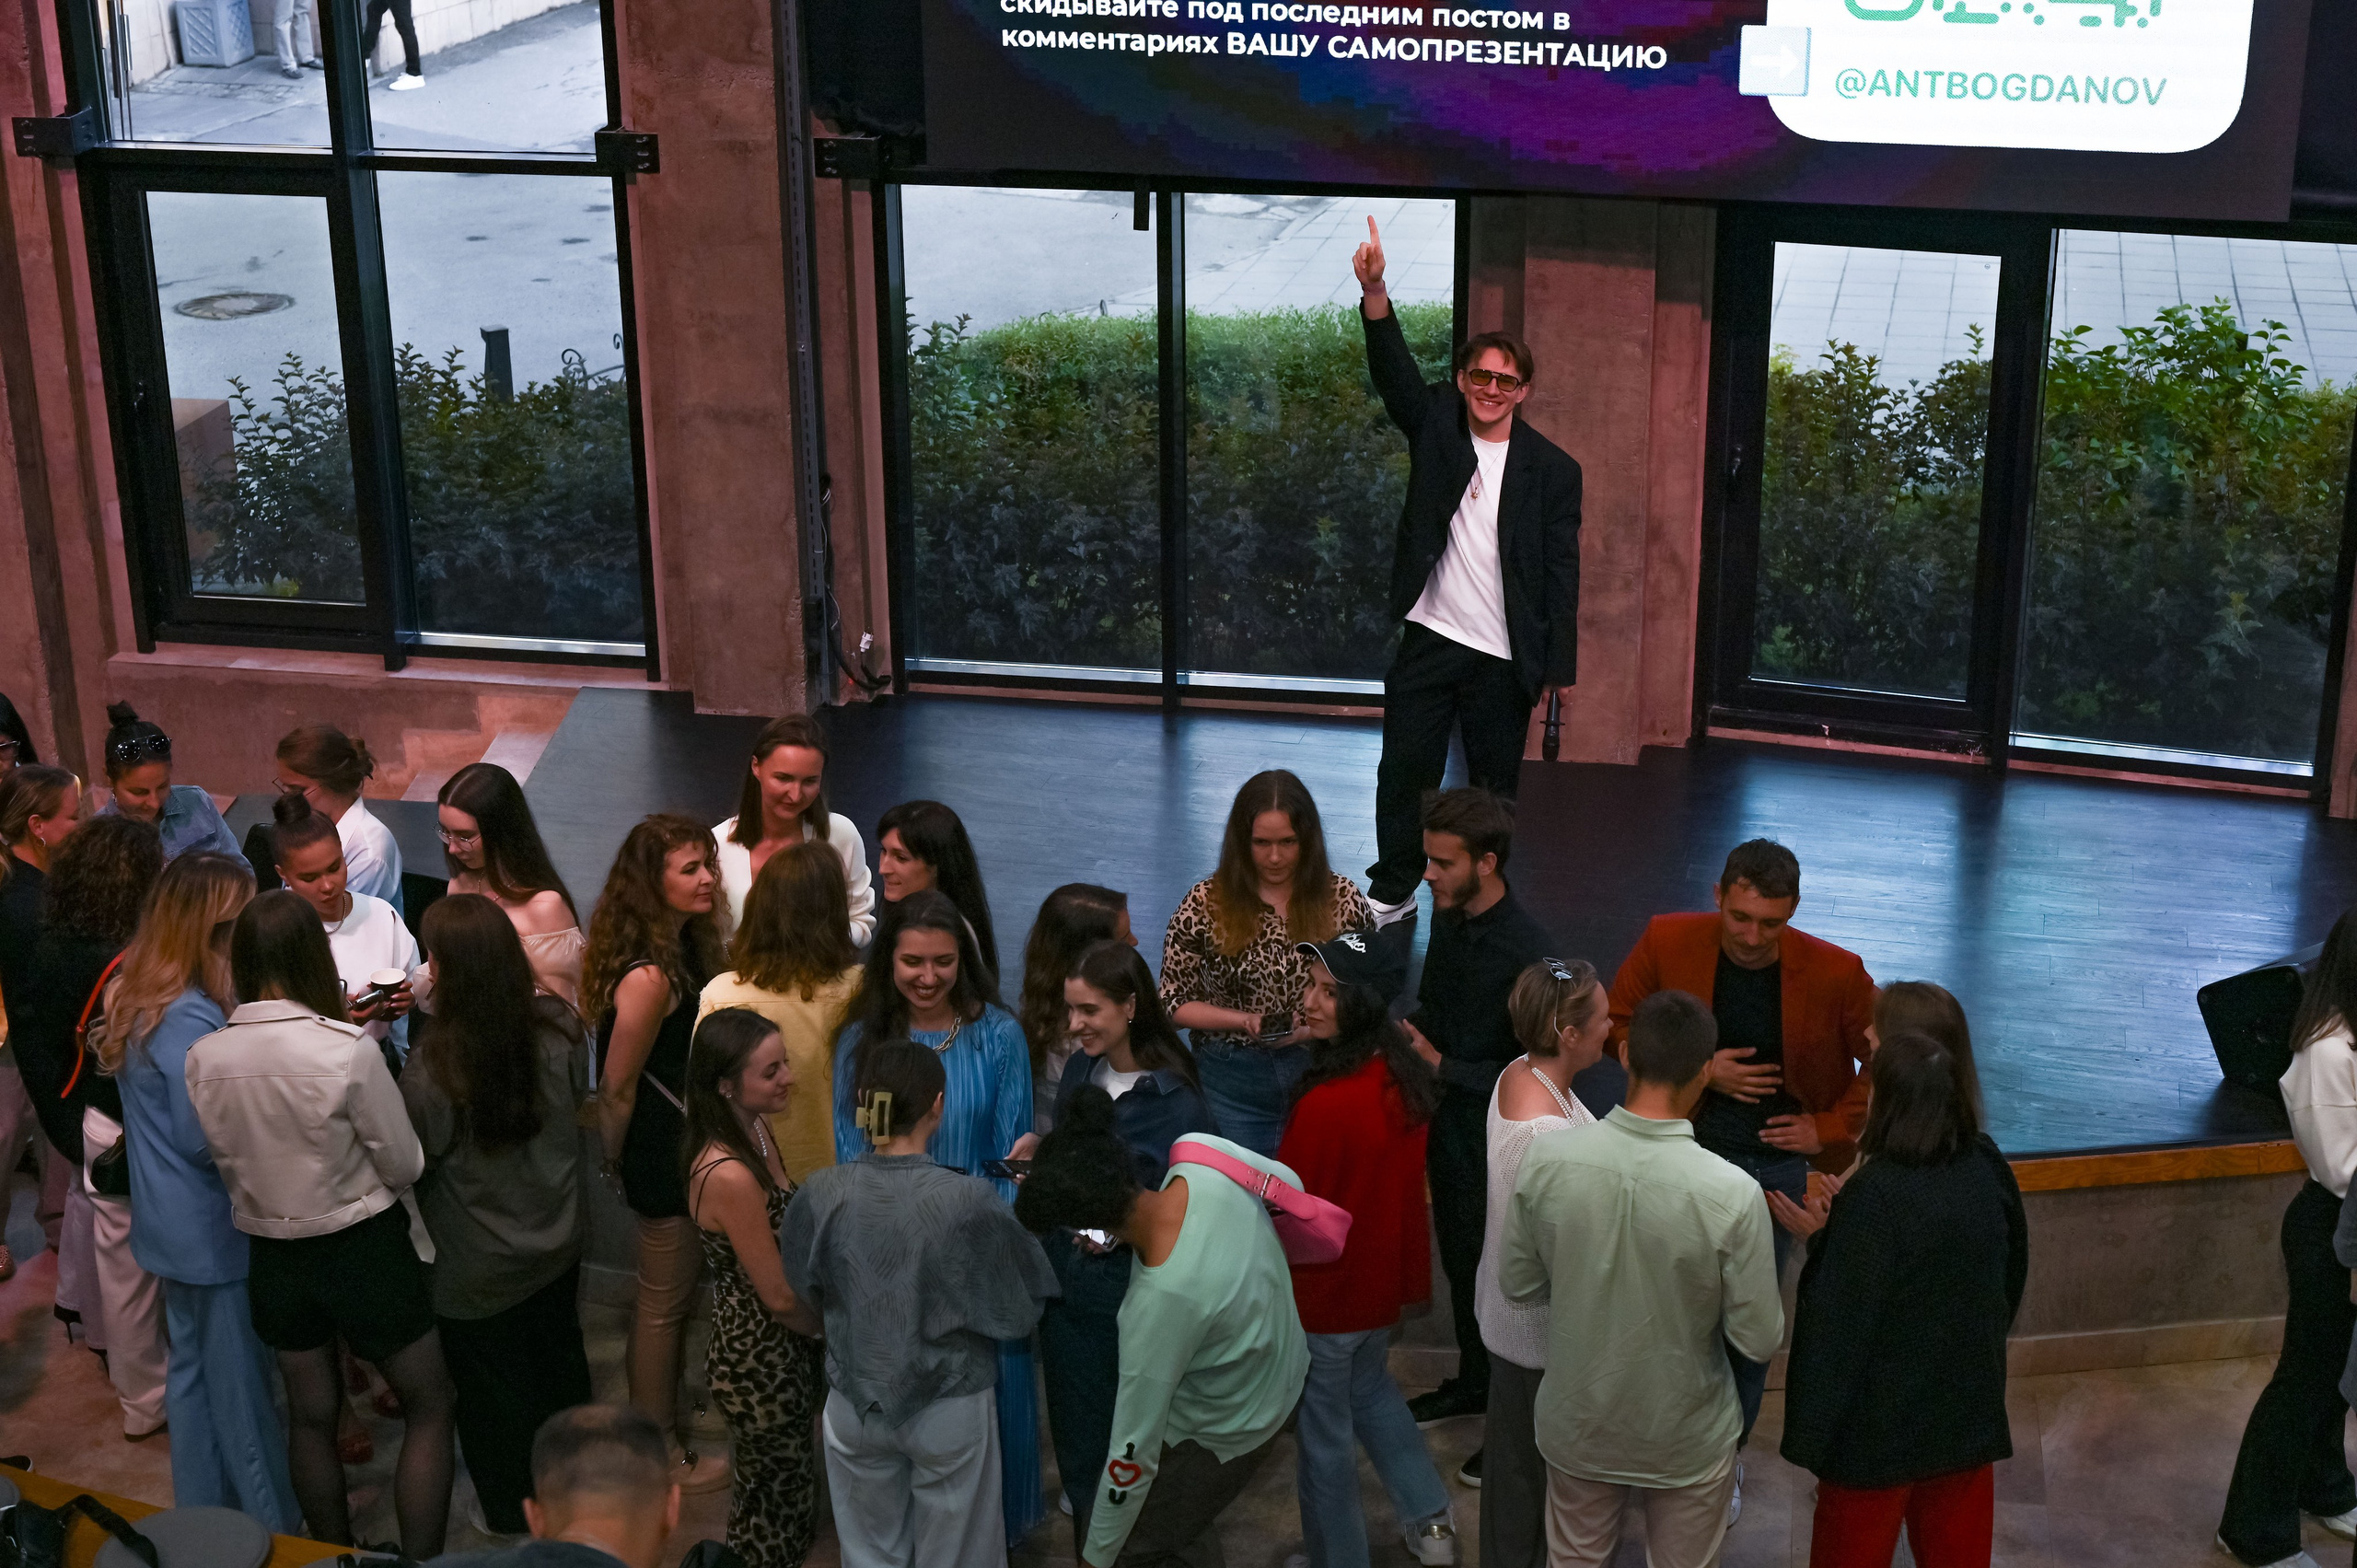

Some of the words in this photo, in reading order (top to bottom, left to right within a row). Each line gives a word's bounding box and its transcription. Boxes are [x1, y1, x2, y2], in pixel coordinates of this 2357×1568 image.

[1188, 1, 1244, 23] под
[1251, 3, 1423, 27] последним
[1433, 8, 1544, 30] постом
[1553, 12, 1571, 30] в
[1002, 29, 1219, 57] комментариях
[1227, 31, 1320, 58] ВАШУ
[1328, 35, 1667, 72] САМОПРЕЗЕНТАЦИЮ
[1835, 68, 2167, 106] @ANTBOGDANOV
